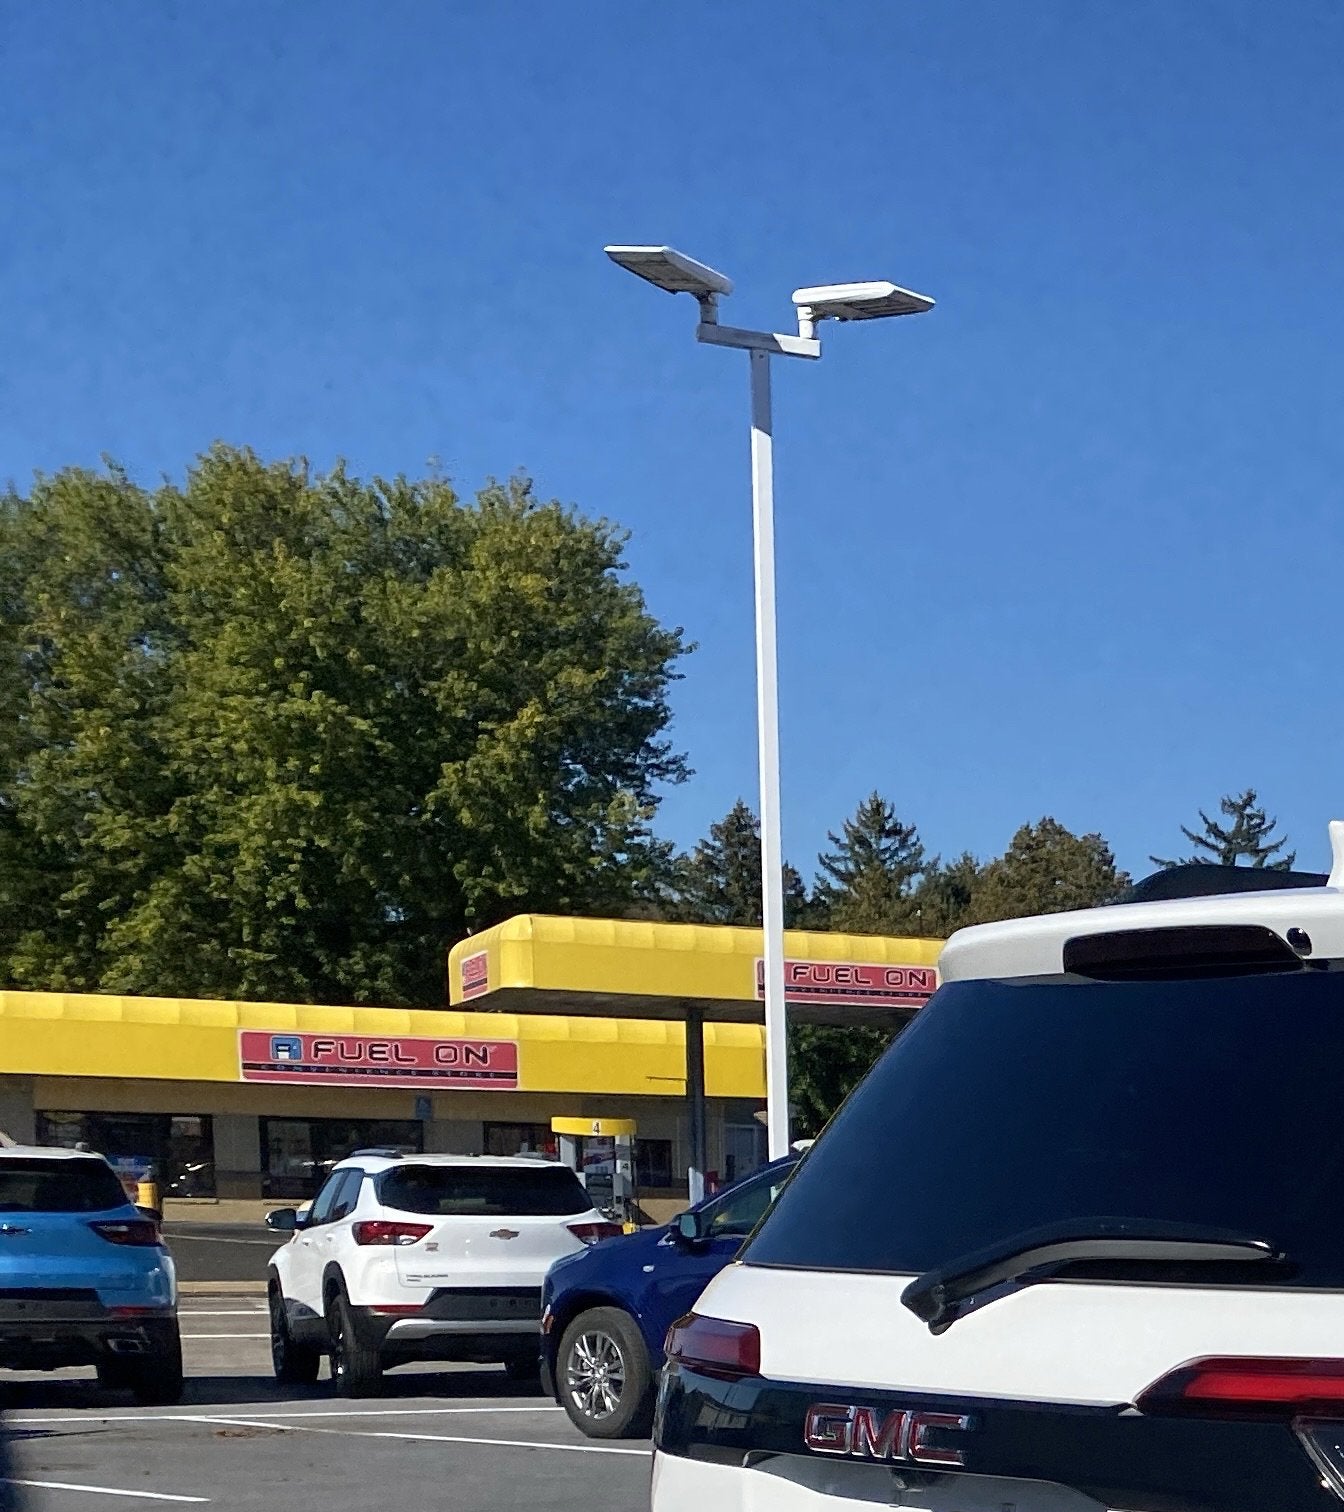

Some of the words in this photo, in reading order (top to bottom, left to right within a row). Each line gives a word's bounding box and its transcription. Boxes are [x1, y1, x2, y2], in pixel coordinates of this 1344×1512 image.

[791, 964, 872, 985] FUEL
[885, 970, 930, 987] ON
[311, 1040, 417, 1063] FUEL
[433, 1043, 492, 1067] ON
[593, 1122, 601, 1134] 4
[804, 1403, 972, 1466] GMC
